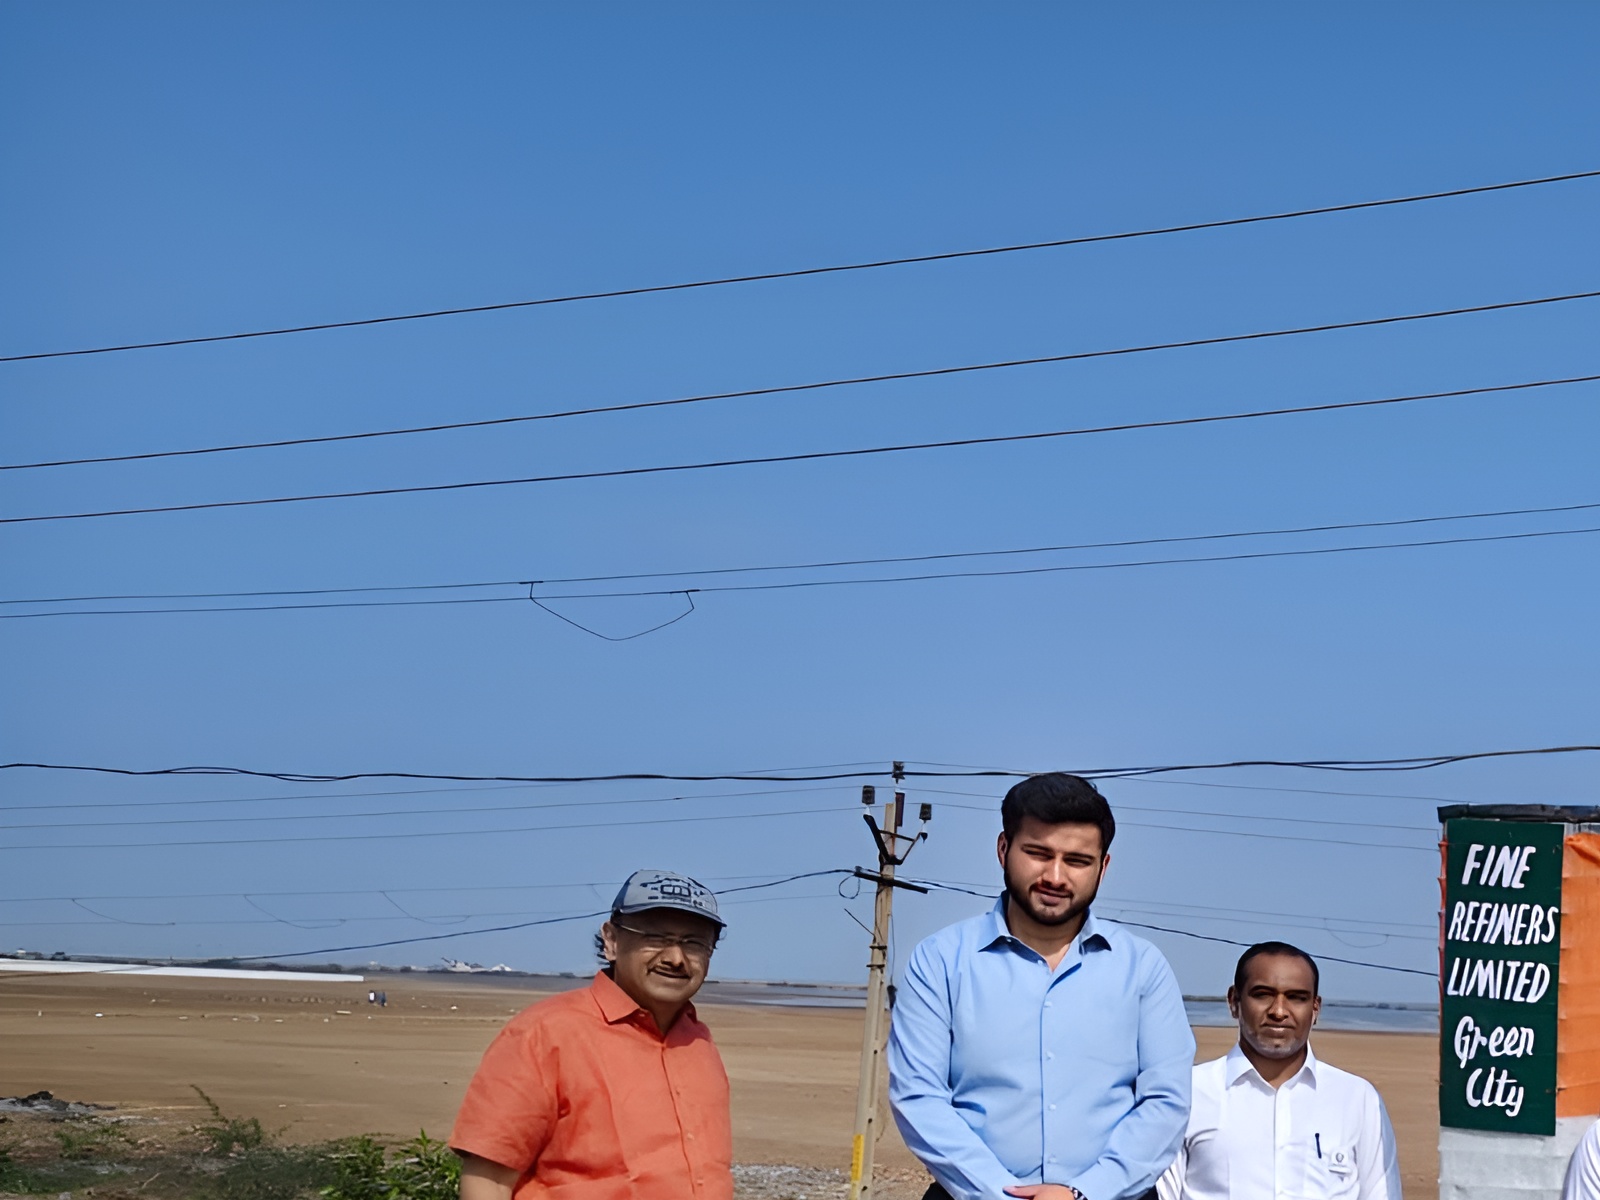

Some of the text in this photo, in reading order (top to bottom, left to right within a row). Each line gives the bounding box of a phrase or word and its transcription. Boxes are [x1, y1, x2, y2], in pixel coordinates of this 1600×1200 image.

[1461, 843, 1537, 889] FINE
[1447, 900, 1559, 946] REFINERS
[1446, 957, 1551, 1004] LIMITED
[1454, 1015, 1535, 1069] Green
